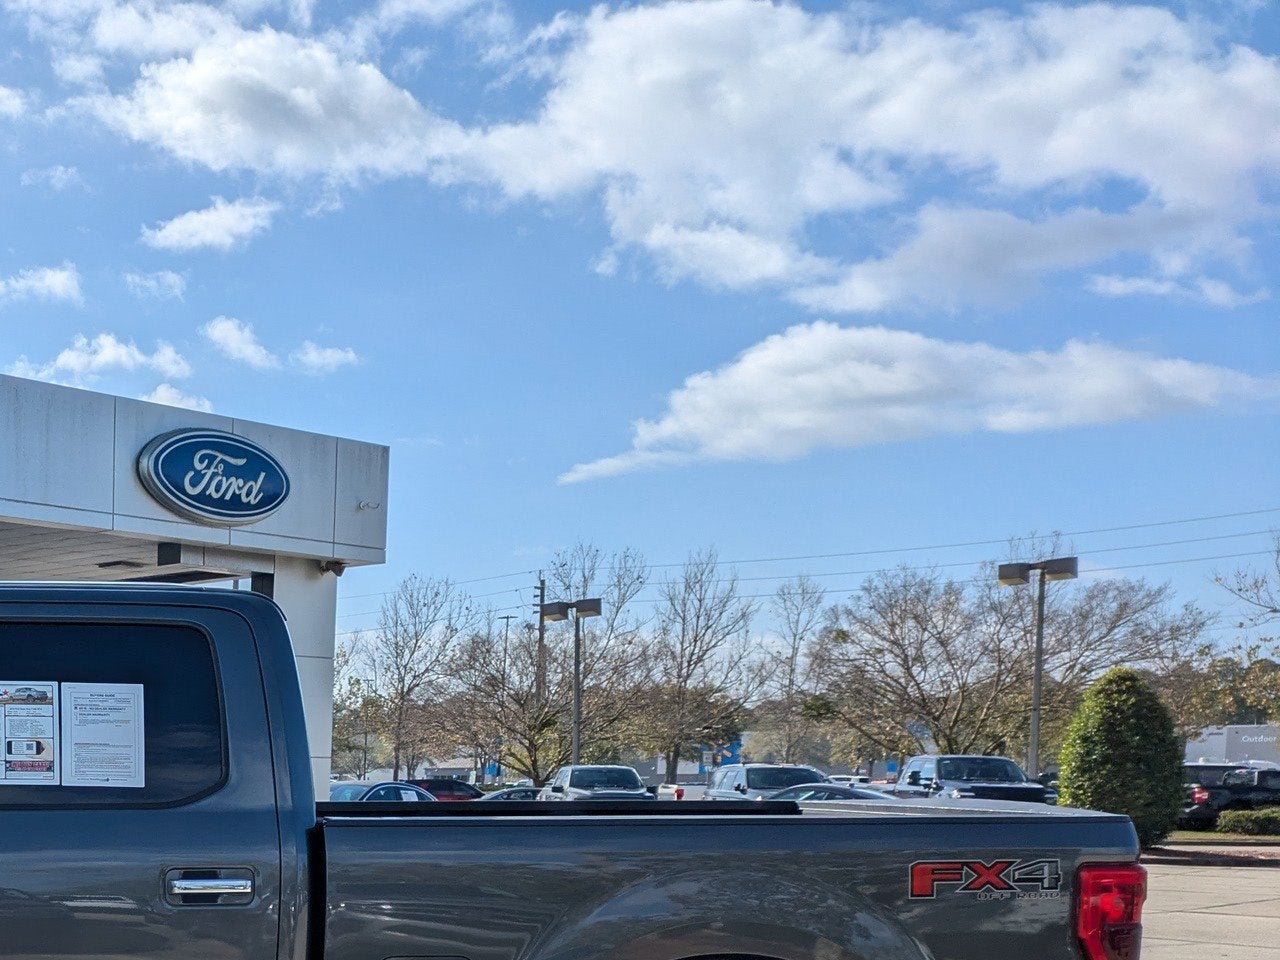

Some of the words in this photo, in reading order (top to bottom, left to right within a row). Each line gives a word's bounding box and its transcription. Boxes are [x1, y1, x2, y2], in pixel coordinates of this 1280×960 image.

[184, 449, 266, 505] Ford
[1241, 735, 1277, 743] Outdoor
[909, 859, 1063, 900] FX4
